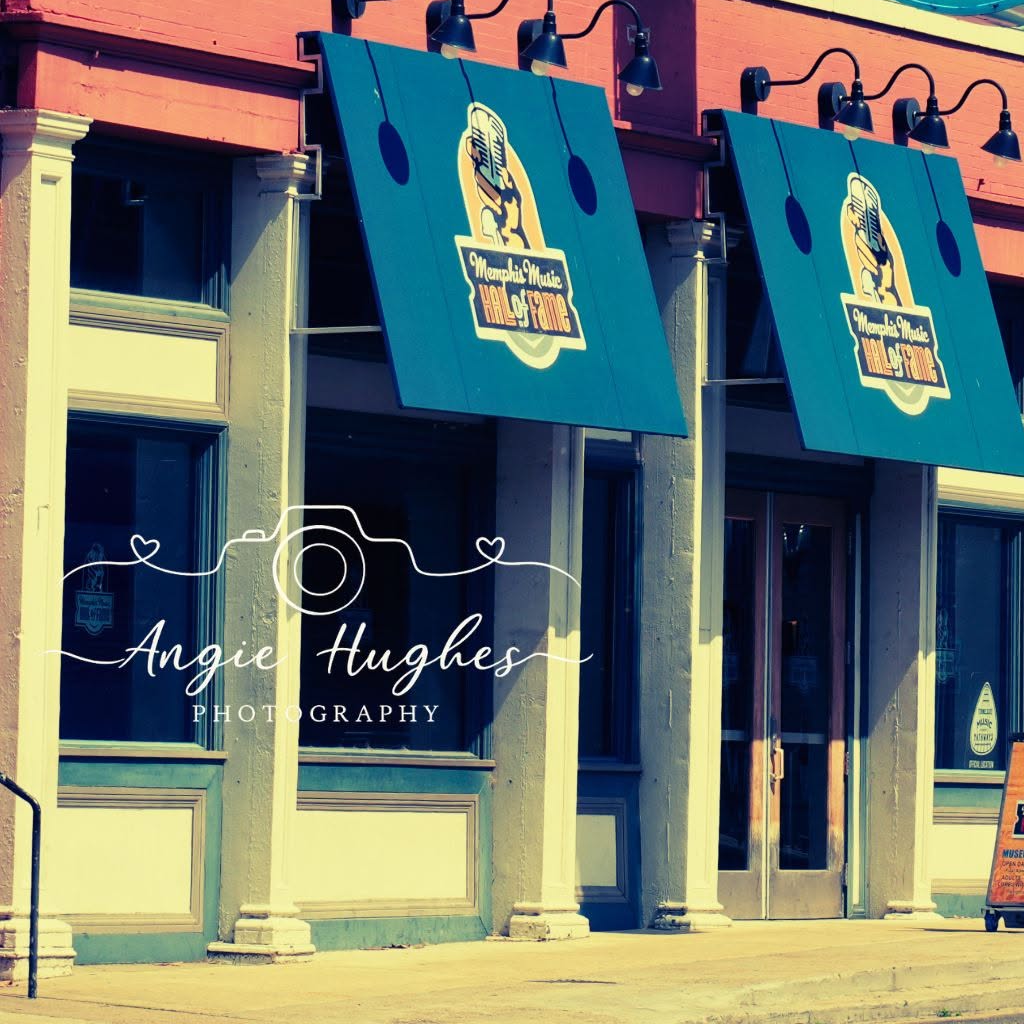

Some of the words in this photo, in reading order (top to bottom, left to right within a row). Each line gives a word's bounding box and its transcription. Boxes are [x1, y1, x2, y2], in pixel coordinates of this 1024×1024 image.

[469, 251, 527, 288] Memphis
[522, 259, 563, 289] Music
[478, 283, 518, 327] HALL
[510, 288, 530, 328] of
[852, 308, 900, 339] Memphis
[896, 315, 930, 343] Music
[861, 336, 894, 377] HALL
[887, 342, 904, 378] of
